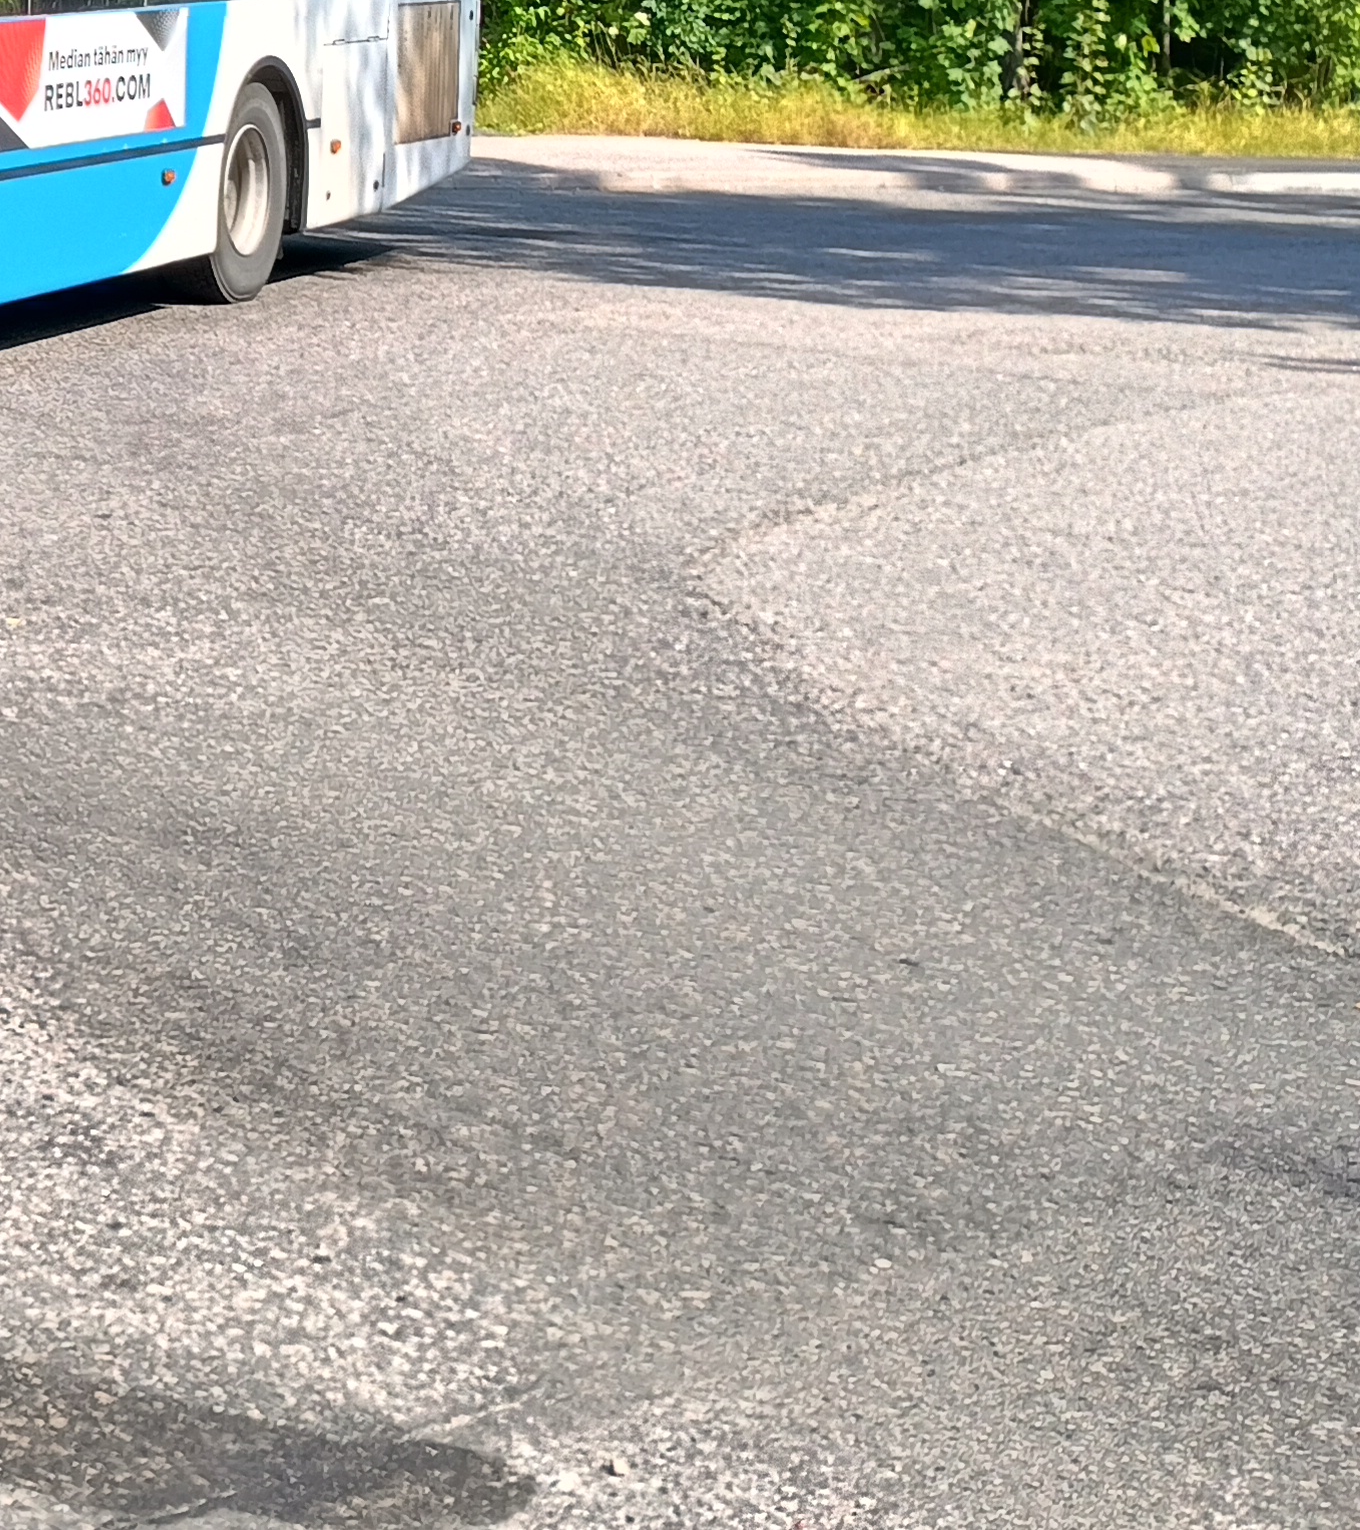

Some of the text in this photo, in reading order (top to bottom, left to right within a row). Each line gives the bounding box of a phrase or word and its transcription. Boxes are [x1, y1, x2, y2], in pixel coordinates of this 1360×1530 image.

[48, 45, 148, 71] Median tähän myy
[44, 73, 151, 112] REBL360.COM
